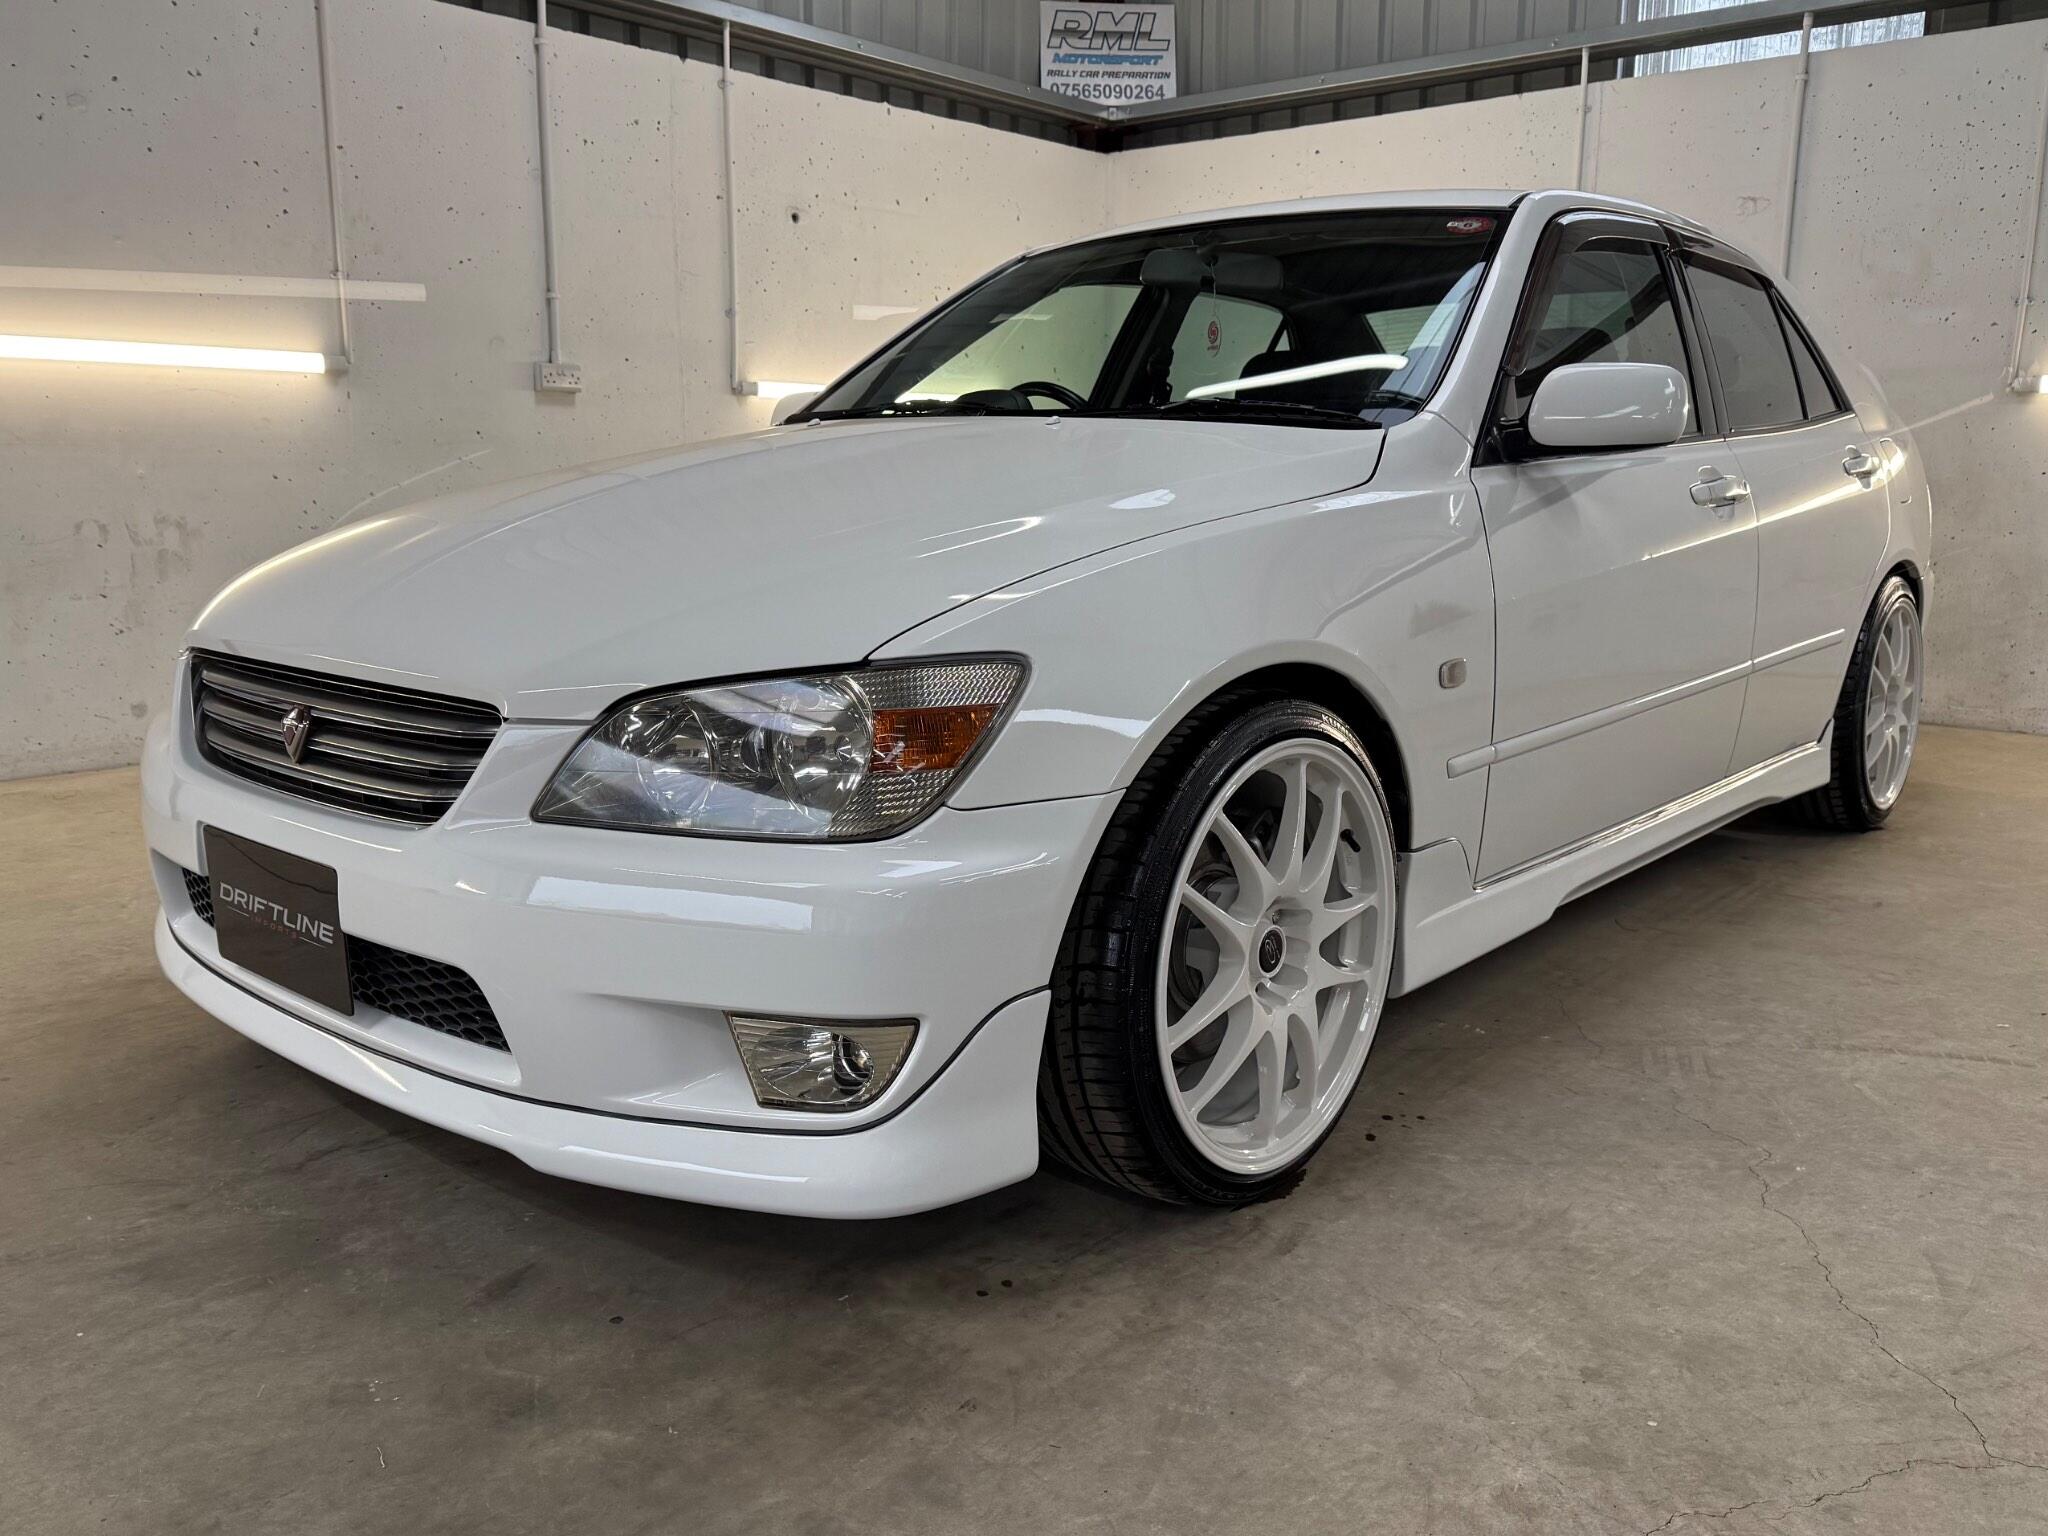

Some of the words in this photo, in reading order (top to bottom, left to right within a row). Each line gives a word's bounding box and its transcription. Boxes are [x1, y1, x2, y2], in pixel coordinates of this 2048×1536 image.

[1047, 10, 1170, 51] RML
[1052, 53, 1163, 65] MOTORSPORT
[1047, 69, 1078, 78] RALLY
[1080, 70, 1100, 78] CAR
[1101, 70, 1171, 79] PREPARATION
[1050, 83, 1165, 100] 07565090264
[219, 882, 334, 944] DRIFTLINE
